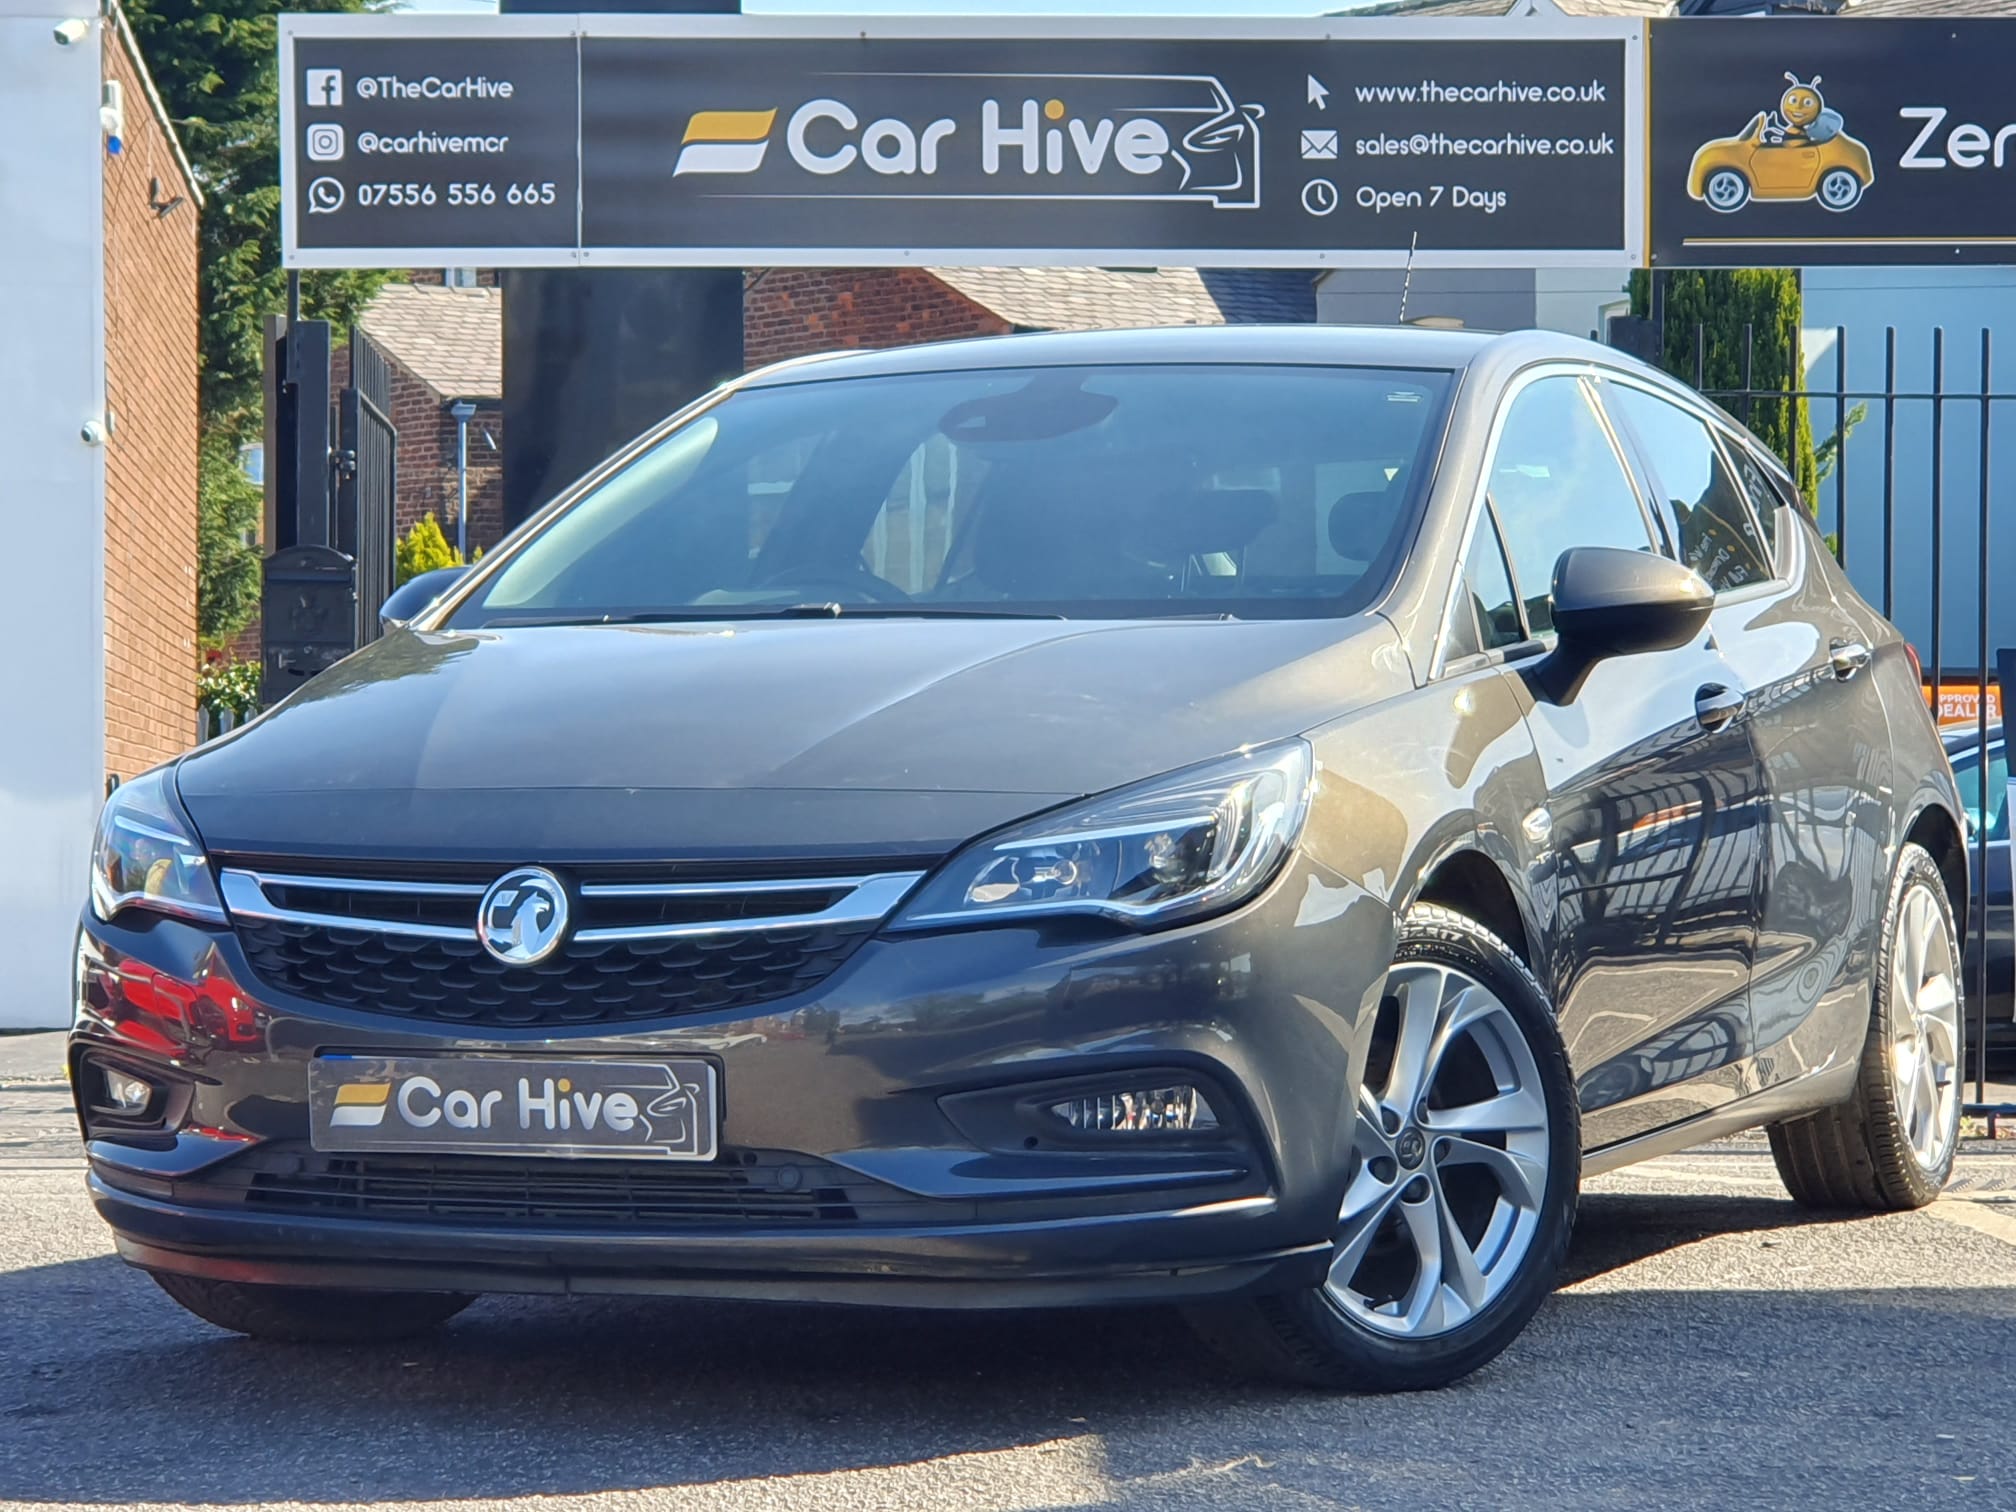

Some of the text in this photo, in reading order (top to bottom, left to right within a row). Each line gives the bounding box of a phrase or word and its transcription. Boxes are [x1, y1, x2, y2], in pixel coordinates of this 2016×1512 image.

[357, 75, 514, 99] @TheCarHive
[1355, 79, 1606, 103] www.thecarhive.co.uk
[357, 131, 510, 154] @carhivemcr
[787, 98, 1169, 175] Car Hive
[1355, 131, 1614, 156] sales@thecarhive.co.uk
[358, 182, 556, 206] 07556 556 665
[1356, 185, 1507, 214] Open 7 Days
[1937, 693, 1996, 704] PPROVD
[396, 1075, 640, 1132] Car Hive
